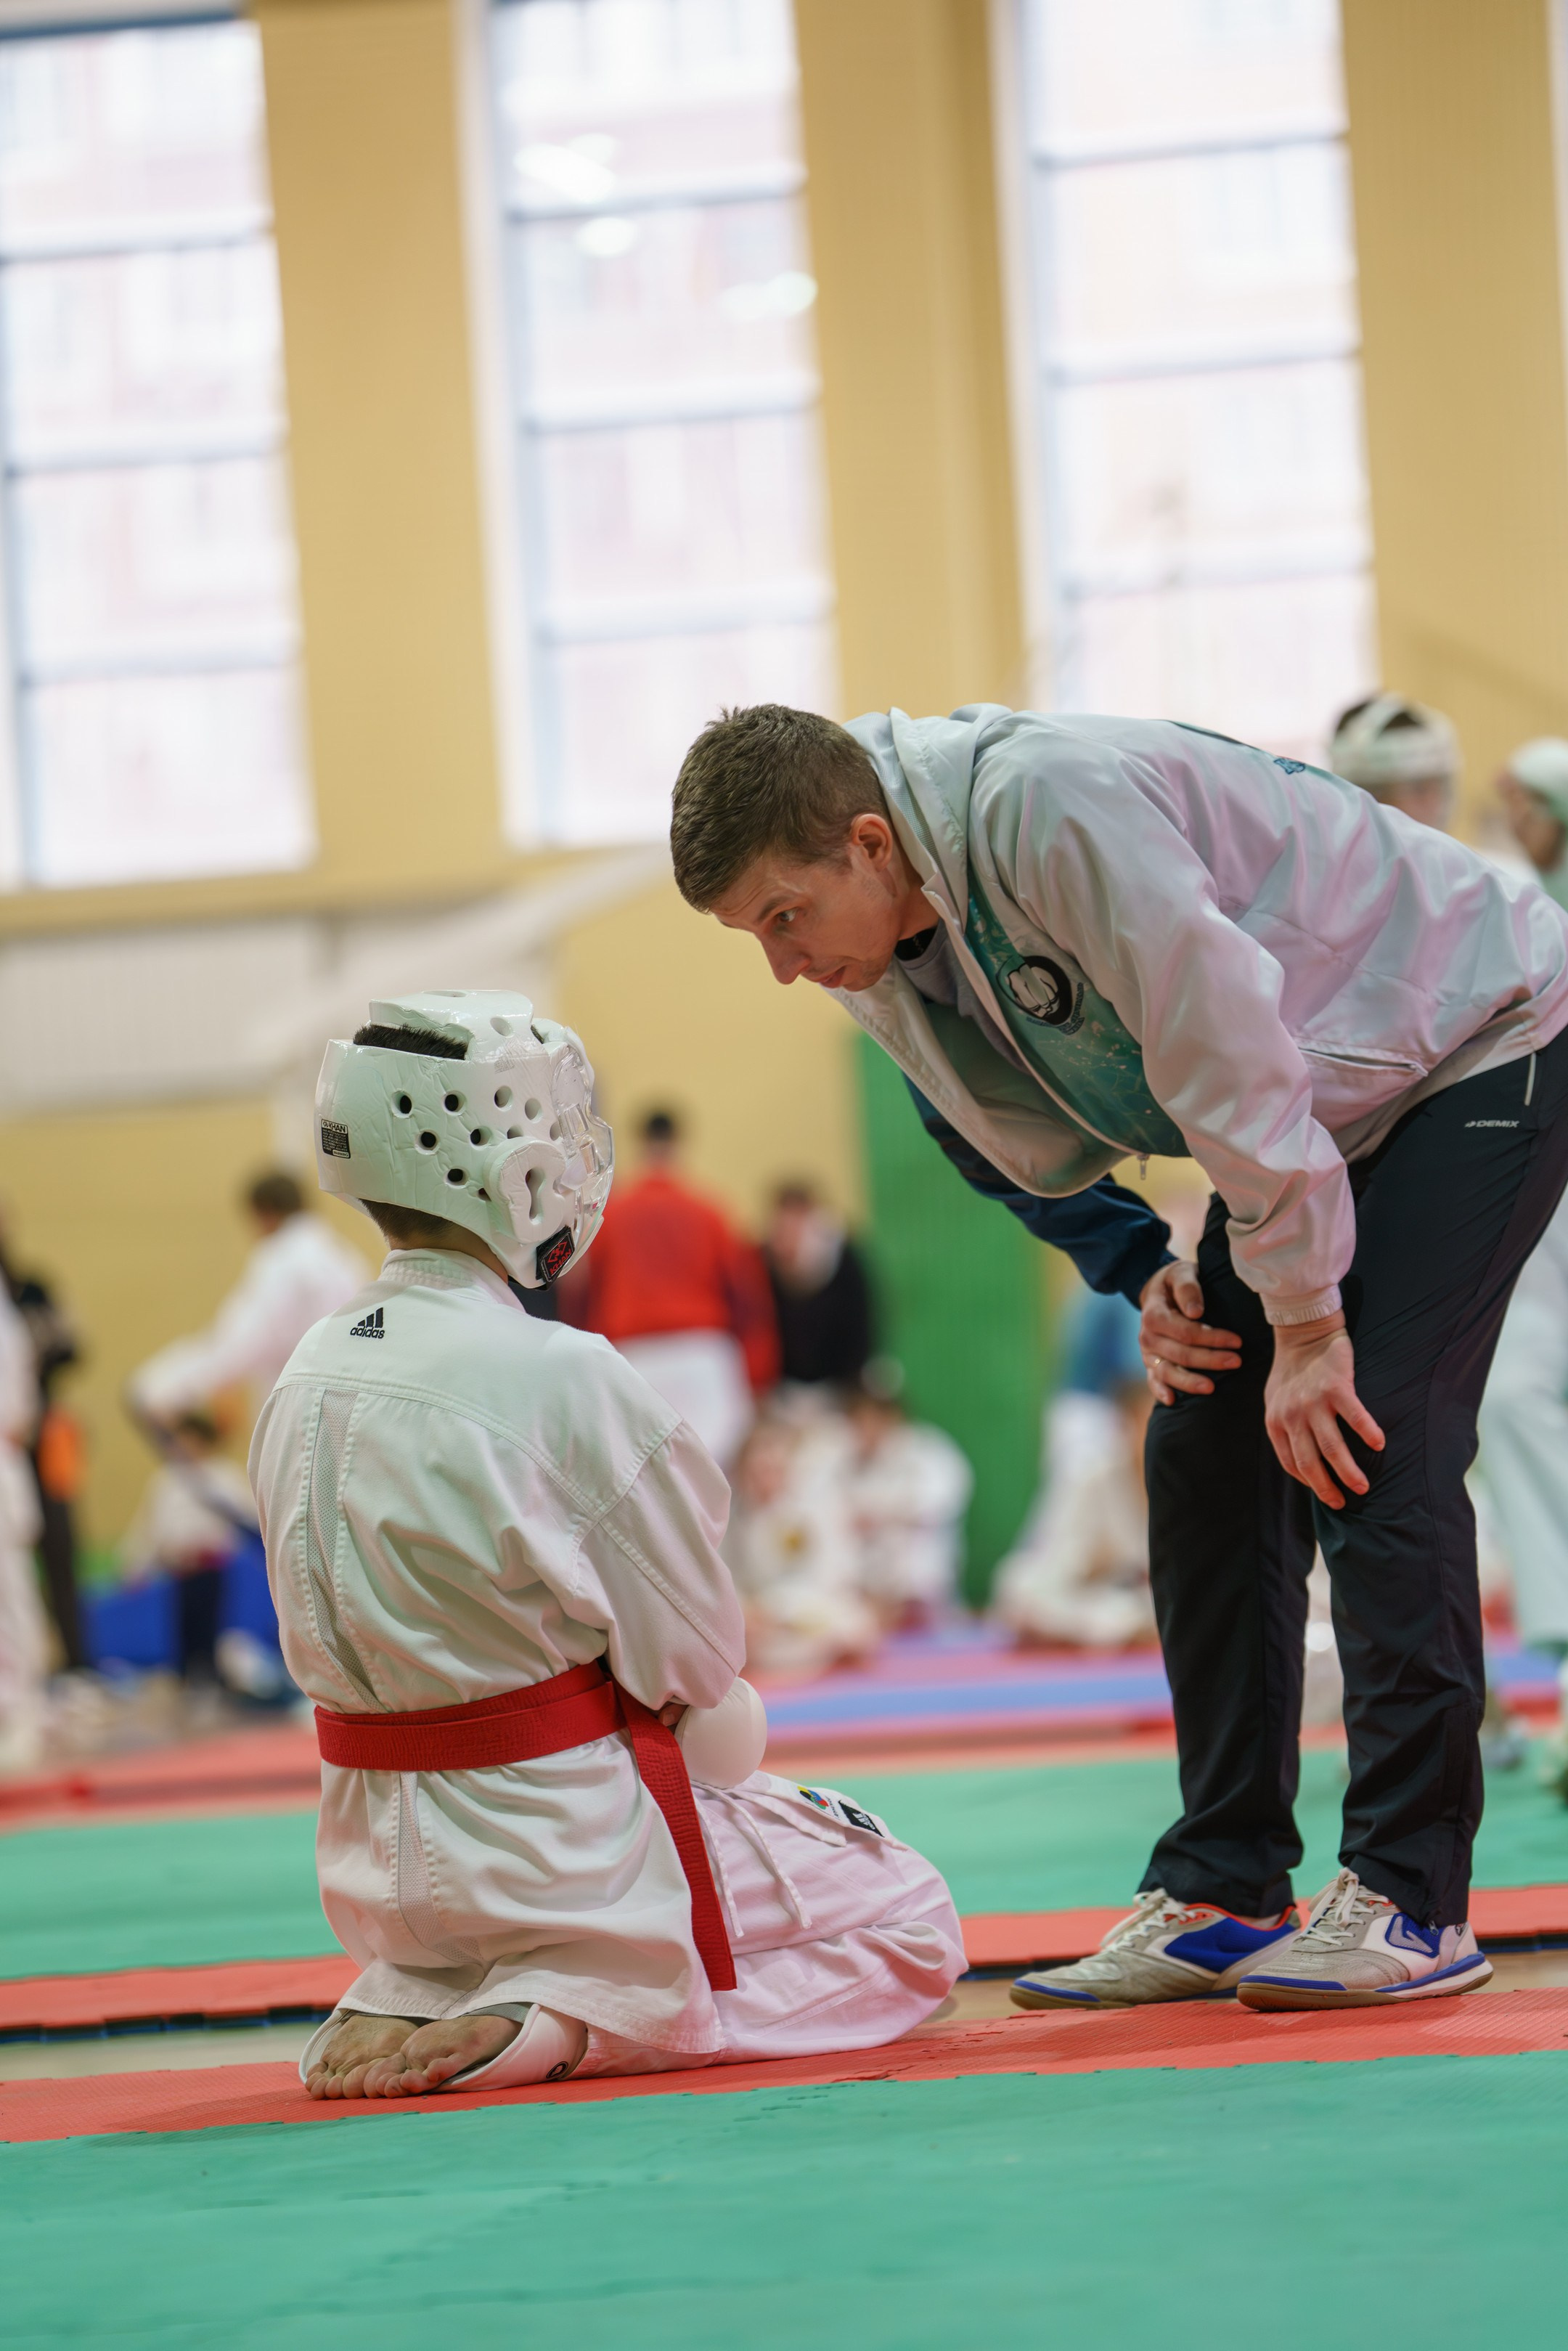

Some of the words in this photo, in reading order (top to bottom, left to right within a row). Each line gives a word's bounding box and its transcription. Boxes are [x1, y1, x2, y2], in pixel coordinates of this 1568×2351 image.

[329, 1122, 346, 1133] KHAN
[1476, 1120, 1520, 1128] DEMIX
[550, 1248, 572, 1274] KHAN
[350, 1325, 385, 1339] adidas
